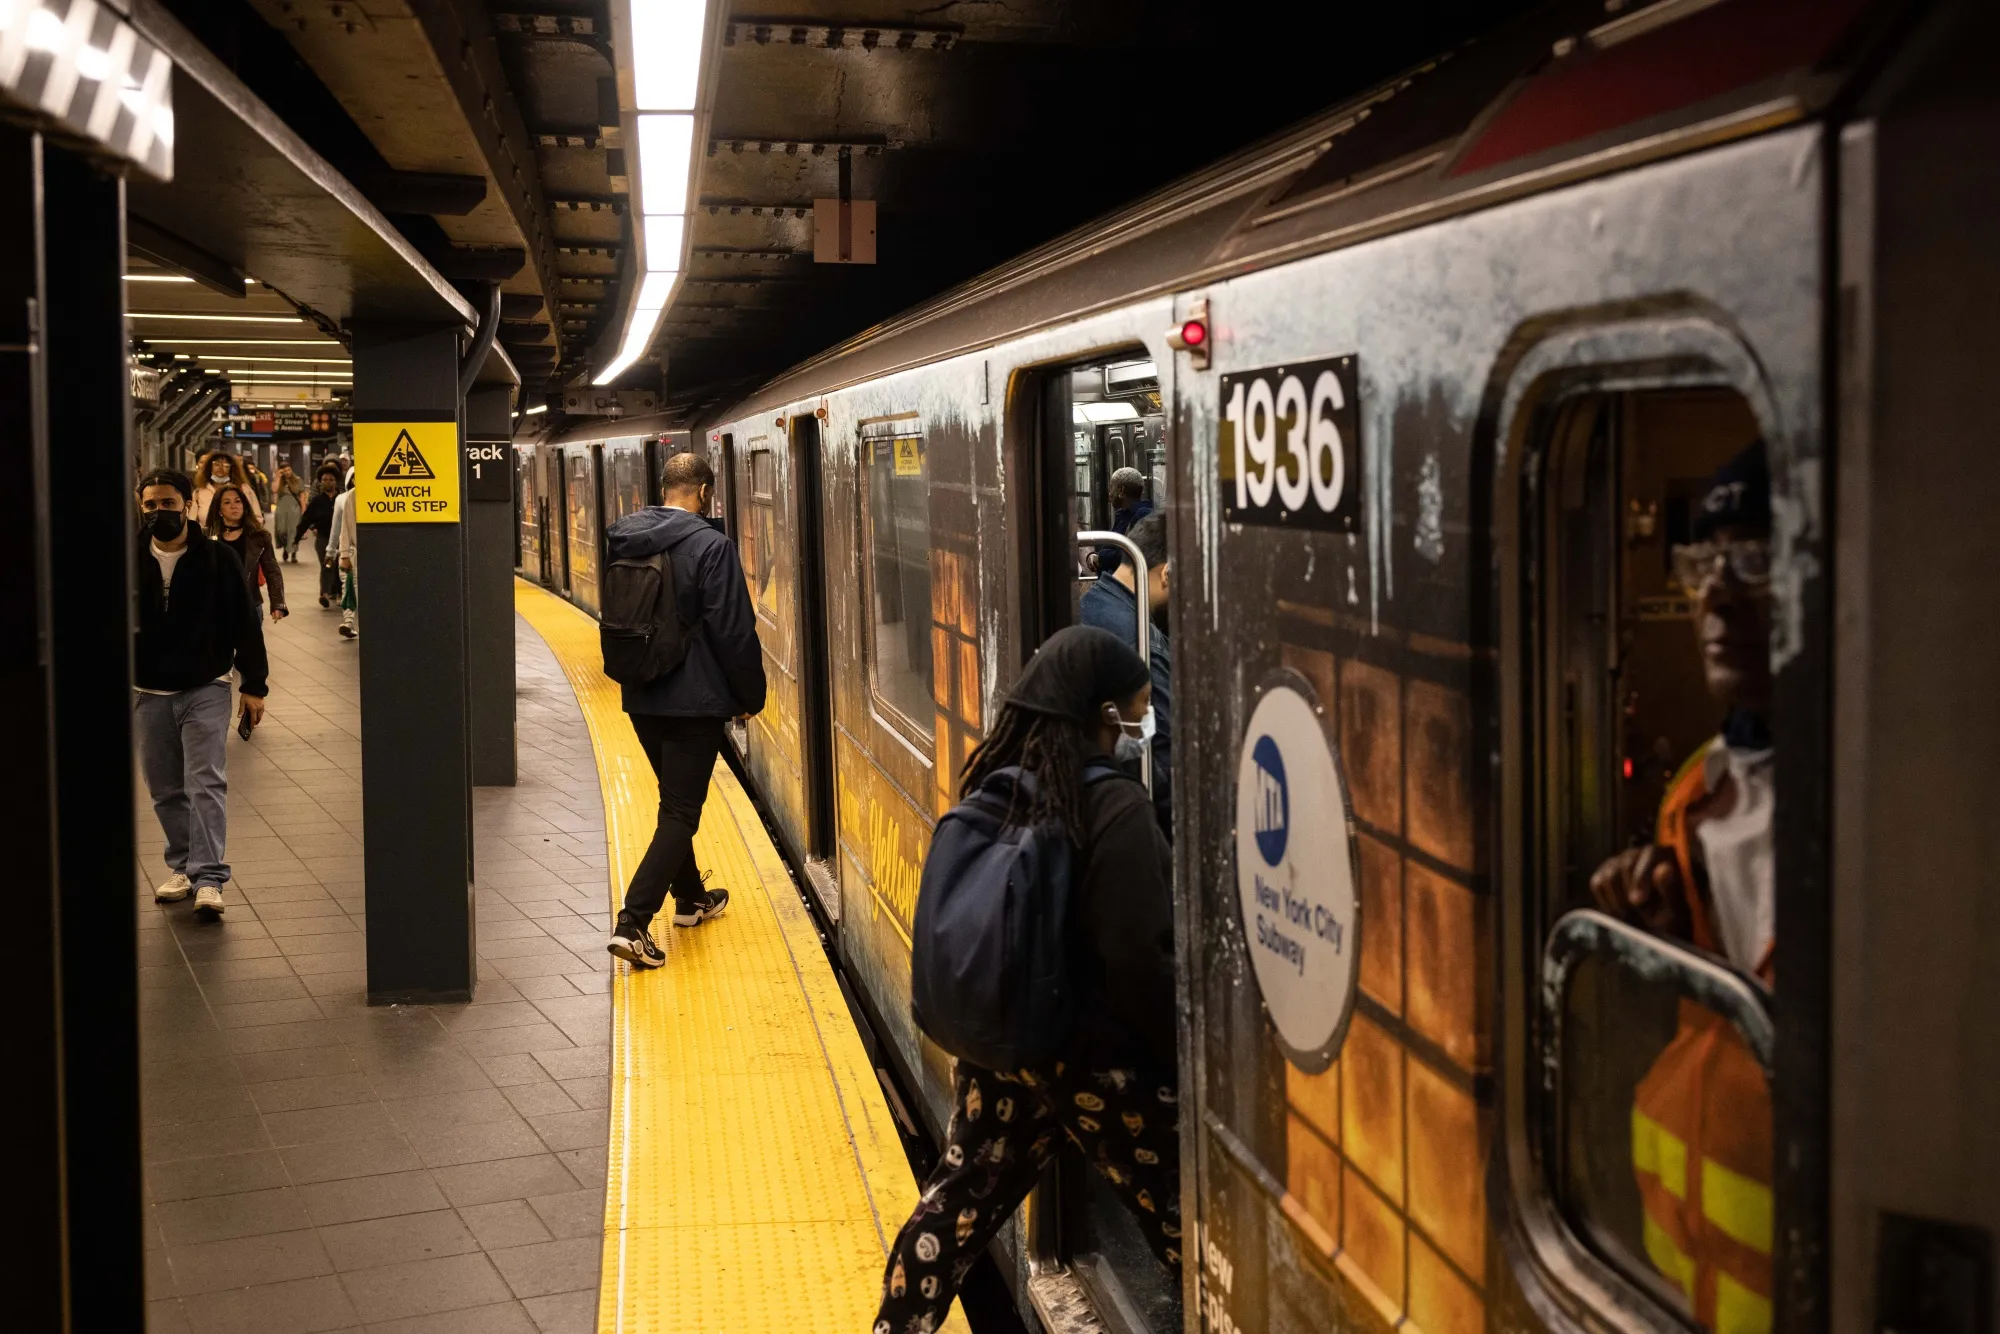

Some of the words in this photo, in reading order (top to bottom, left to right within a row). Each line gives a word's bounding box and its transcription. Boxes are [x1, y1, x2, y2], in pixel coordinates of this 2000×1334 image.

[472, 463, 481, 479] 1
[1226, 369, 1345, 513] 1936
[367, 501, 406, 513] YOUR
[412, 500, 448, 512] STEP
[383, 486, 431, 498] WATCH
[869, 797, 923, 930] Yellow
[1254, 874, 1280, 908] New
[1282, 888, 1313, 931] York
[1314, 903, 1345, 955] City
[1256, 913, 1306, 977] Subway
[1193, 1220, 1233, 1295] New
[1195, 1273, 1242, 1334] Epis
